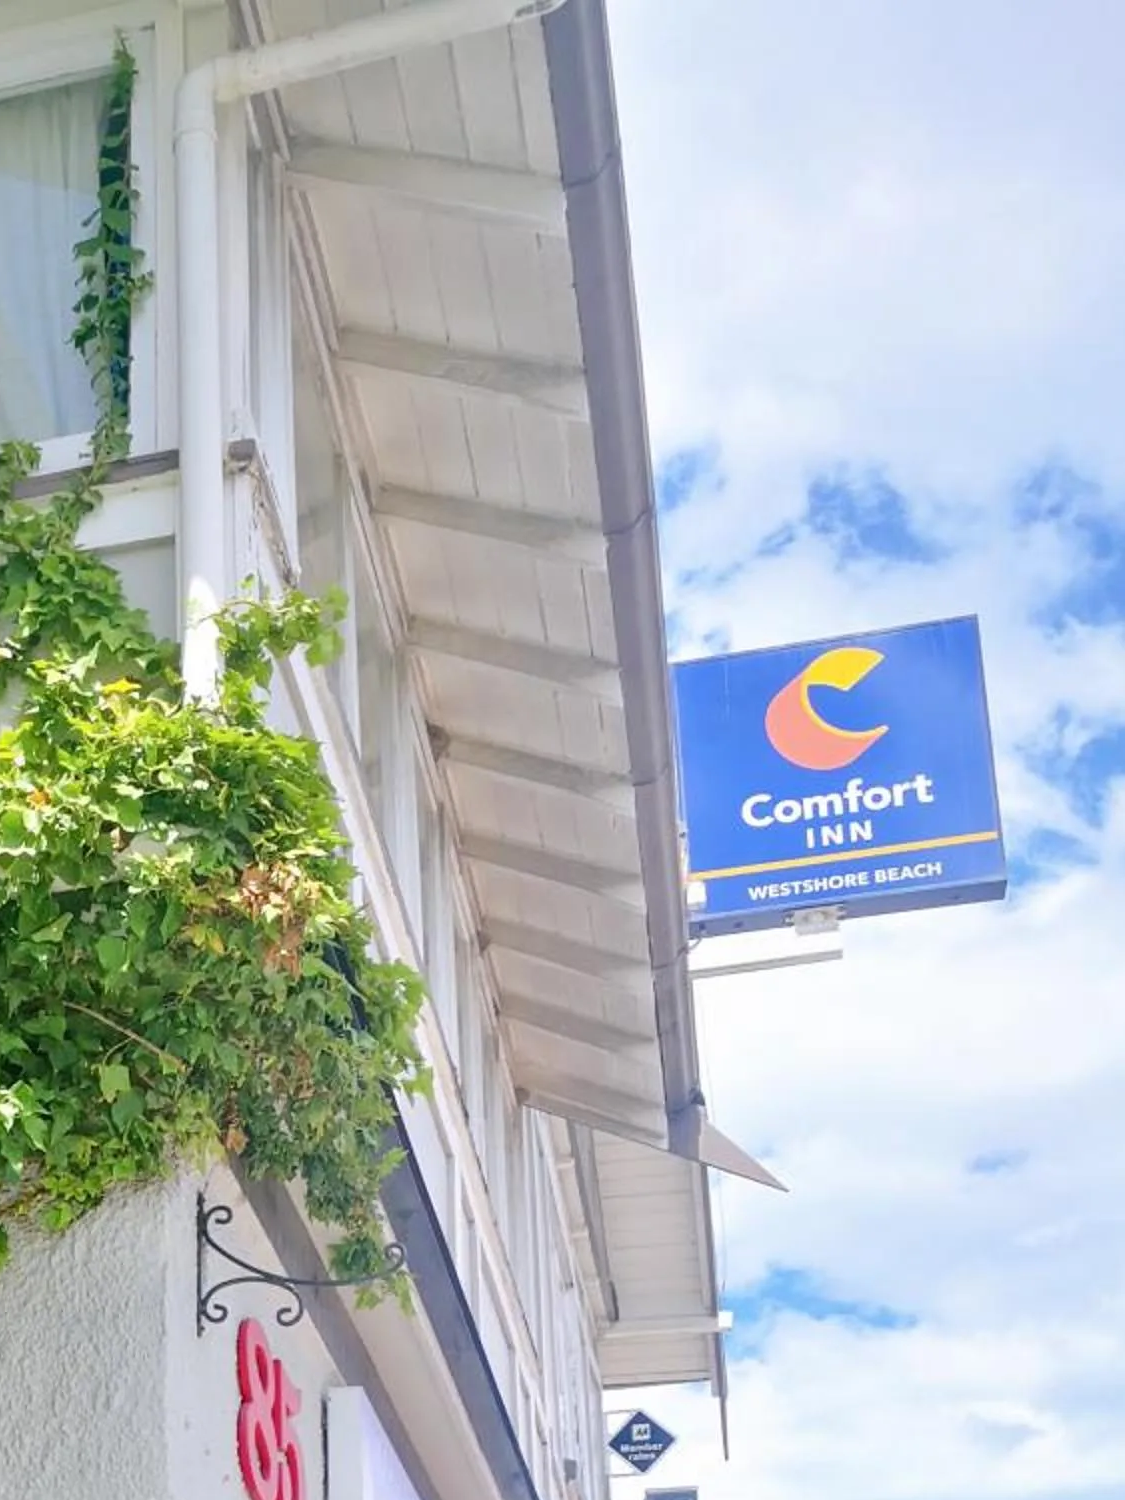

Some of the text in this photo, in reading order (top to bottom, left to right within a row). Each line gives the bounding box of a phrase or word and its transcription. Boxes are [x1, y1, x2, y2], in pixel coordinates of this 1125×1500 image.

[741, 773, 934, 828] Comfort
[806, 819, 873, 849] INN
[748, 862, 943, 901] WESTSHORE BEACH
